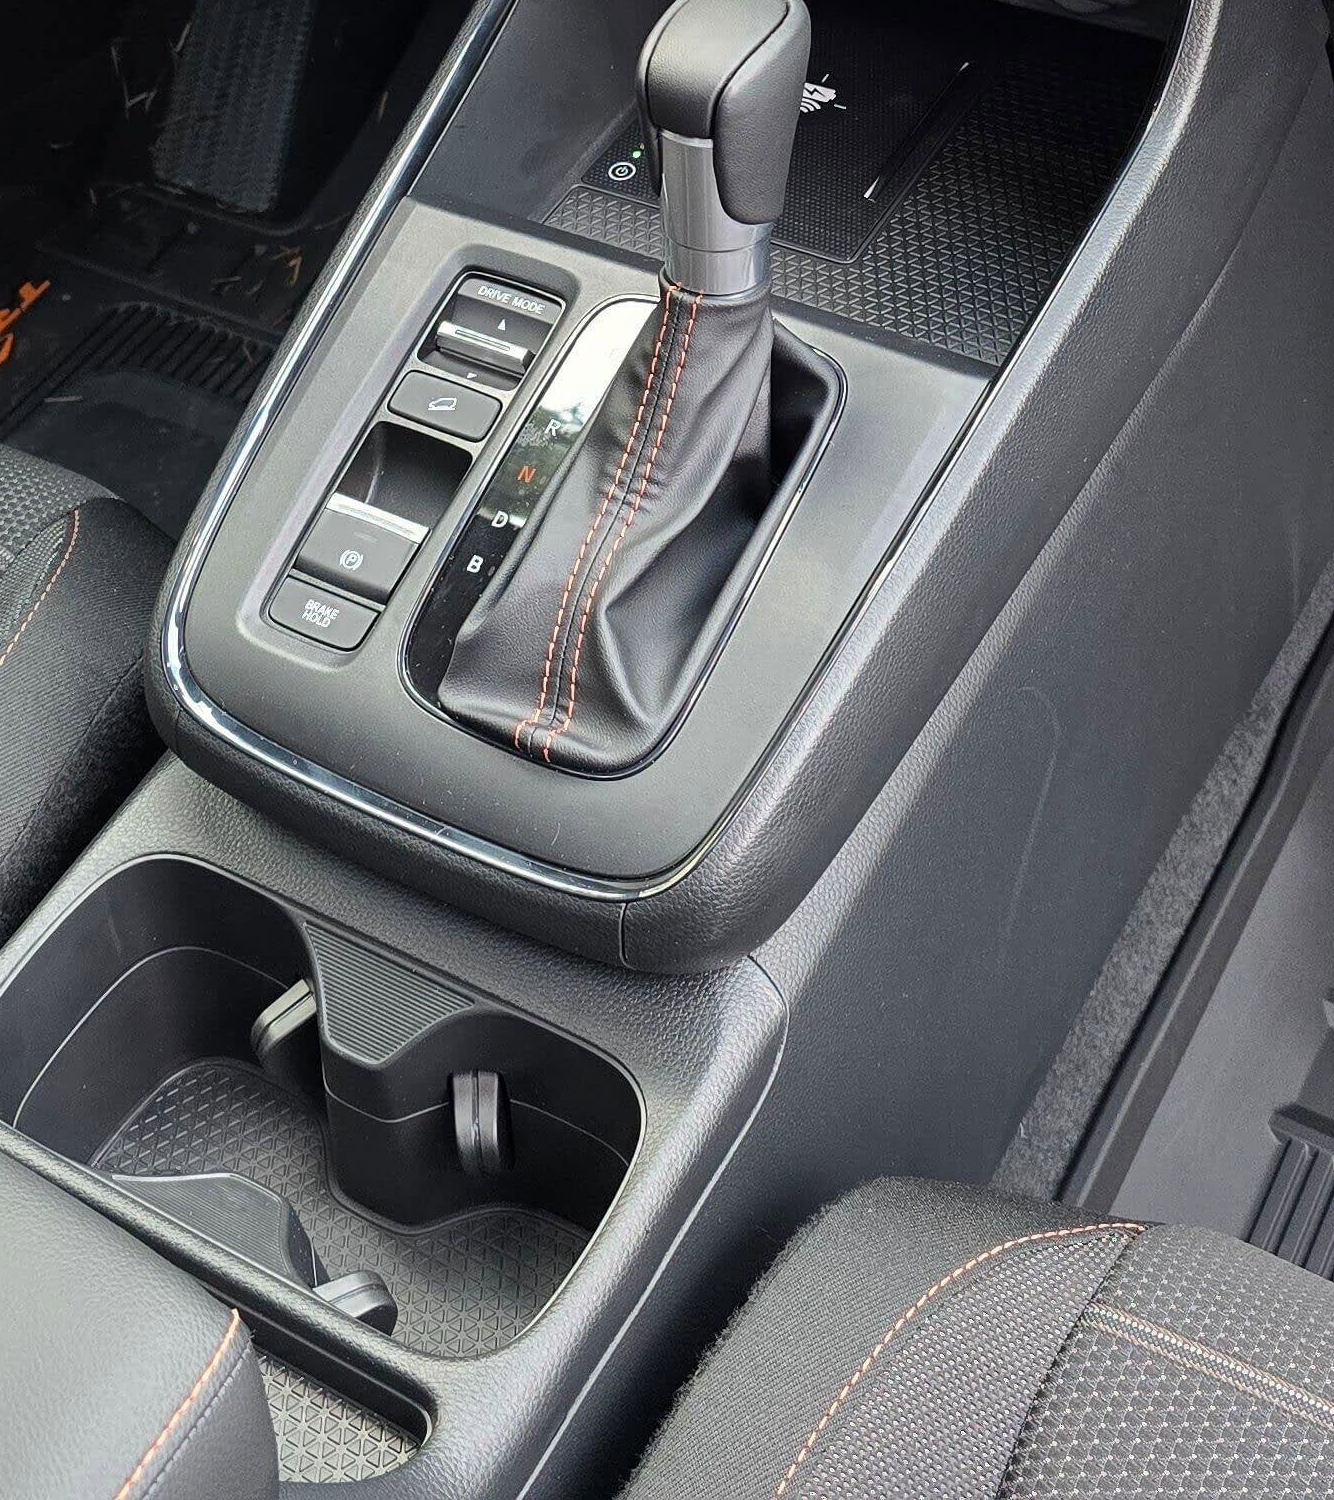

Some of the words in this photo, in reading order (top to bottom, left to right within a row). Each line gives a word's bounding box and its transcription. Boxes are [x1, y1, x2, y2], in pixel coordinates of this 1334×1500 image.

[477, 285, 512, 304] DRIVE
[511, 296, 546, 315] MODE
[544, 418, 562, 437] R
[517, 465, 537, 484] N
[491, 510, 509, 529] D
[466, 554, 484, 574] B
[301, 609, 331, 628] HOLD
[304, 598, 340, 620] BRAKE
